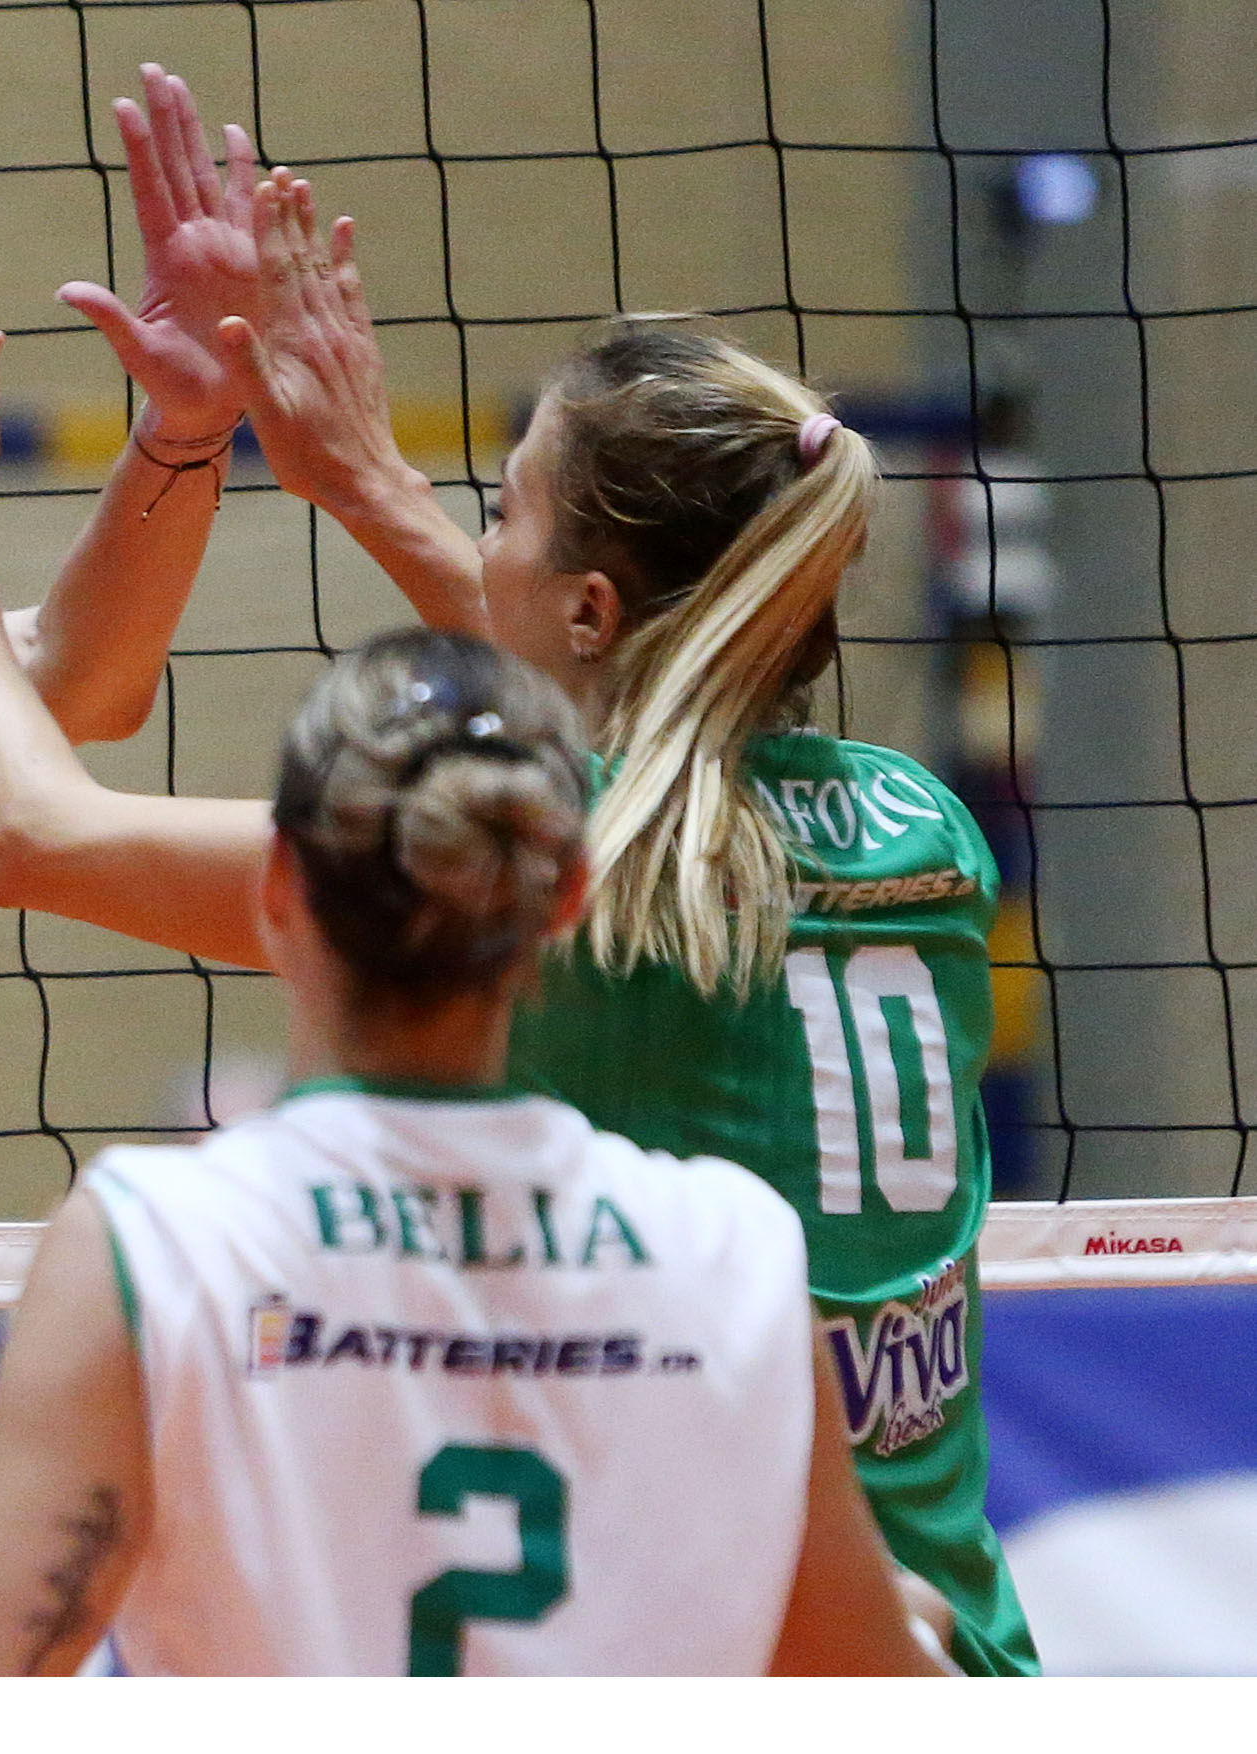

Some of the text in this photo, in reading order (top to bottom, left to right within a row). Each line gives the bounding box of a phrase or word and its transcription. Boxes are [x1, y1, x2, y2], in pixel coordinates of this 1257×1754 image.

[785, 945, 958, 1215] 10
[309, 1182, 656, 1268] BELIA
[409, 1444, 572, 1677] 2
